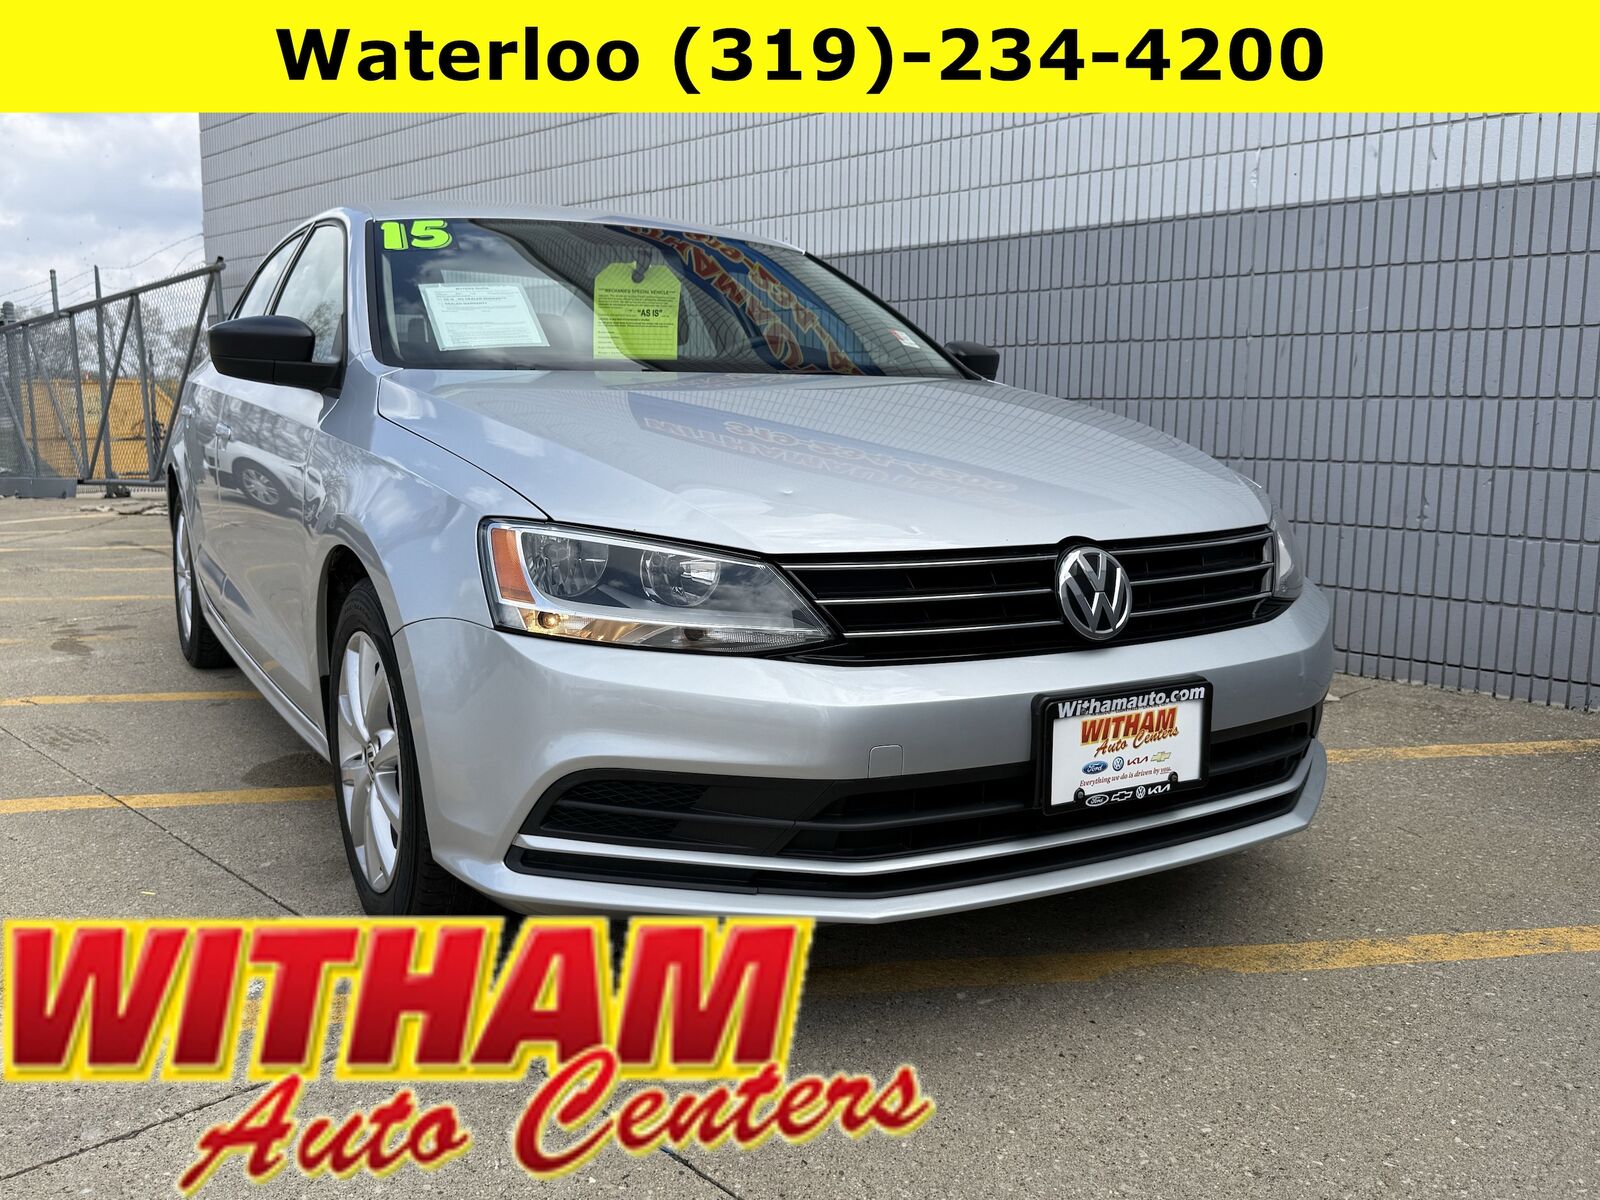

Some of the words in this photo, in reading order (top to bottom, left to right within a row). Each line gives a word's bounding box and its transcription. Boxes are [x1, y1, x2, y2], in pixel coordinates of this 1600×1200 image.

[381, 219, 452, 249] 15
[638, 309, 651, 317] "AS
[652, 309, 662, 317] IS"
[1058, 687, 1205, 718] Withamauto.com
[1081, 706, 1178, 745] WITHAM
[1094, 737, 1127, 757] Auto
[1132, 728, 1179, 746] Centers
[1080, 775, 1111, 787] Everything
[1120, 772, 1128, 780] do
[1134, 768, 1152, 777] driven
[1153, 767, 1160, 775] by
